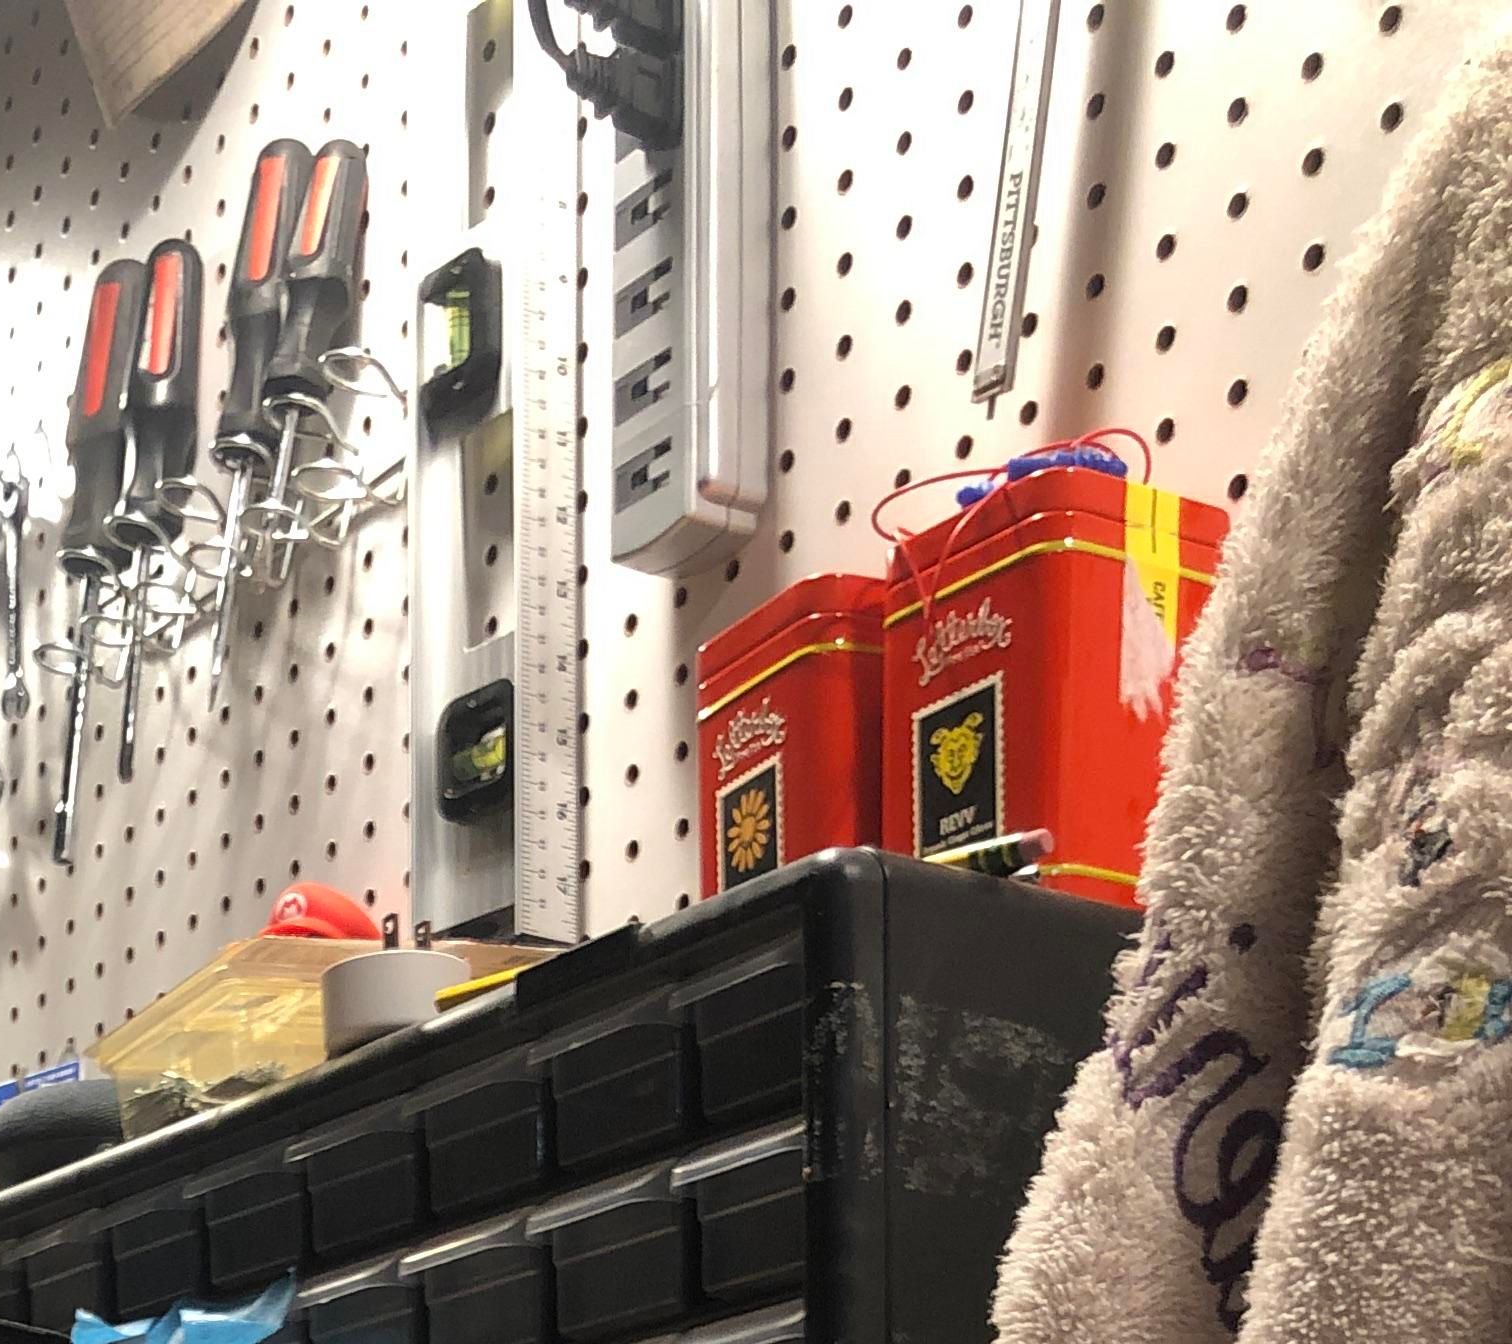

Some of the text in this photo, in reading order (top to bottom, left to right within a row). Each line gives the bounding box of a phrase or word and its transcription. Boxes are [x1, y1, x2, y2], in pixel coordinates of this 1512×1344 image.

[988, 170, 1024, 347] PITTSBURGH
[556, 355, 568, 375] 10
[556, 430, 567, 447] 11
[556, 506, 567, 524] 12
[556, 580, 567, 598] 13
[556, 654, 567, 672] 14
[556, 728, 567, 745] 15
[556, 801, 568, 820] 16
[556, 875, 567, 894] 17
